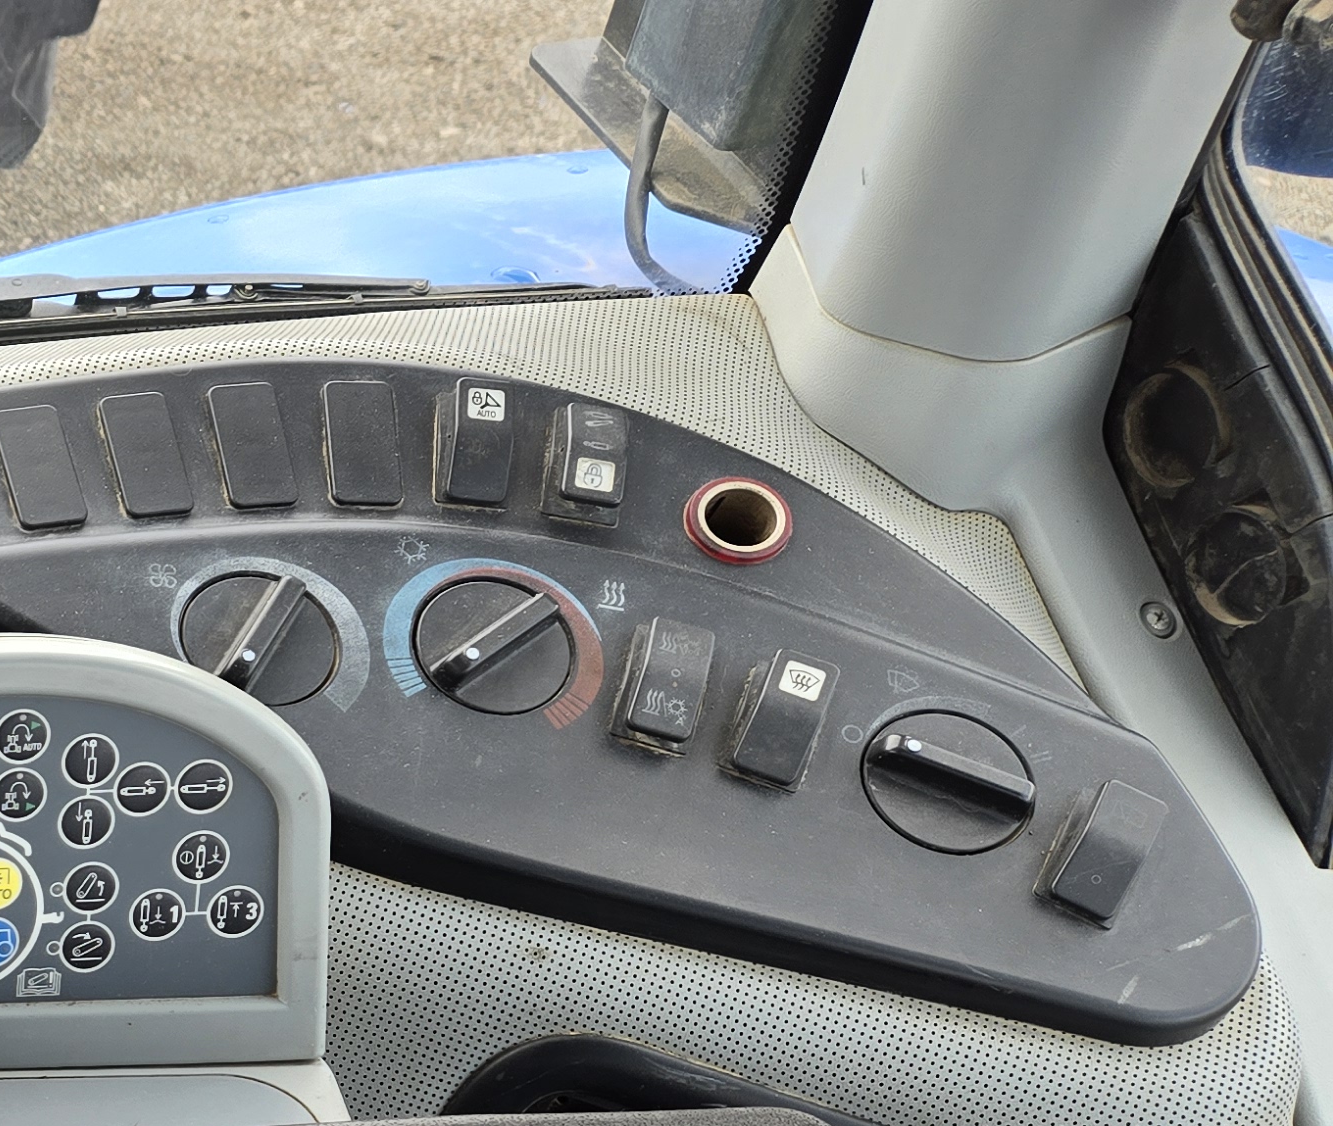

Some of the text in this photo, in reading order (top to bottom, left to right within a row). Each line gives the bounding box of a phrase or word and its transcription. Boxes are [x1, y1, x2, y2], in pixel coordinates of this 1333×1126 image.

[476, 409, 497, 418] AUTO
[22, 742, 42, 751] AUTO
[170, 905, 179, 923] 1
[245, 902, 258, 920] 3
